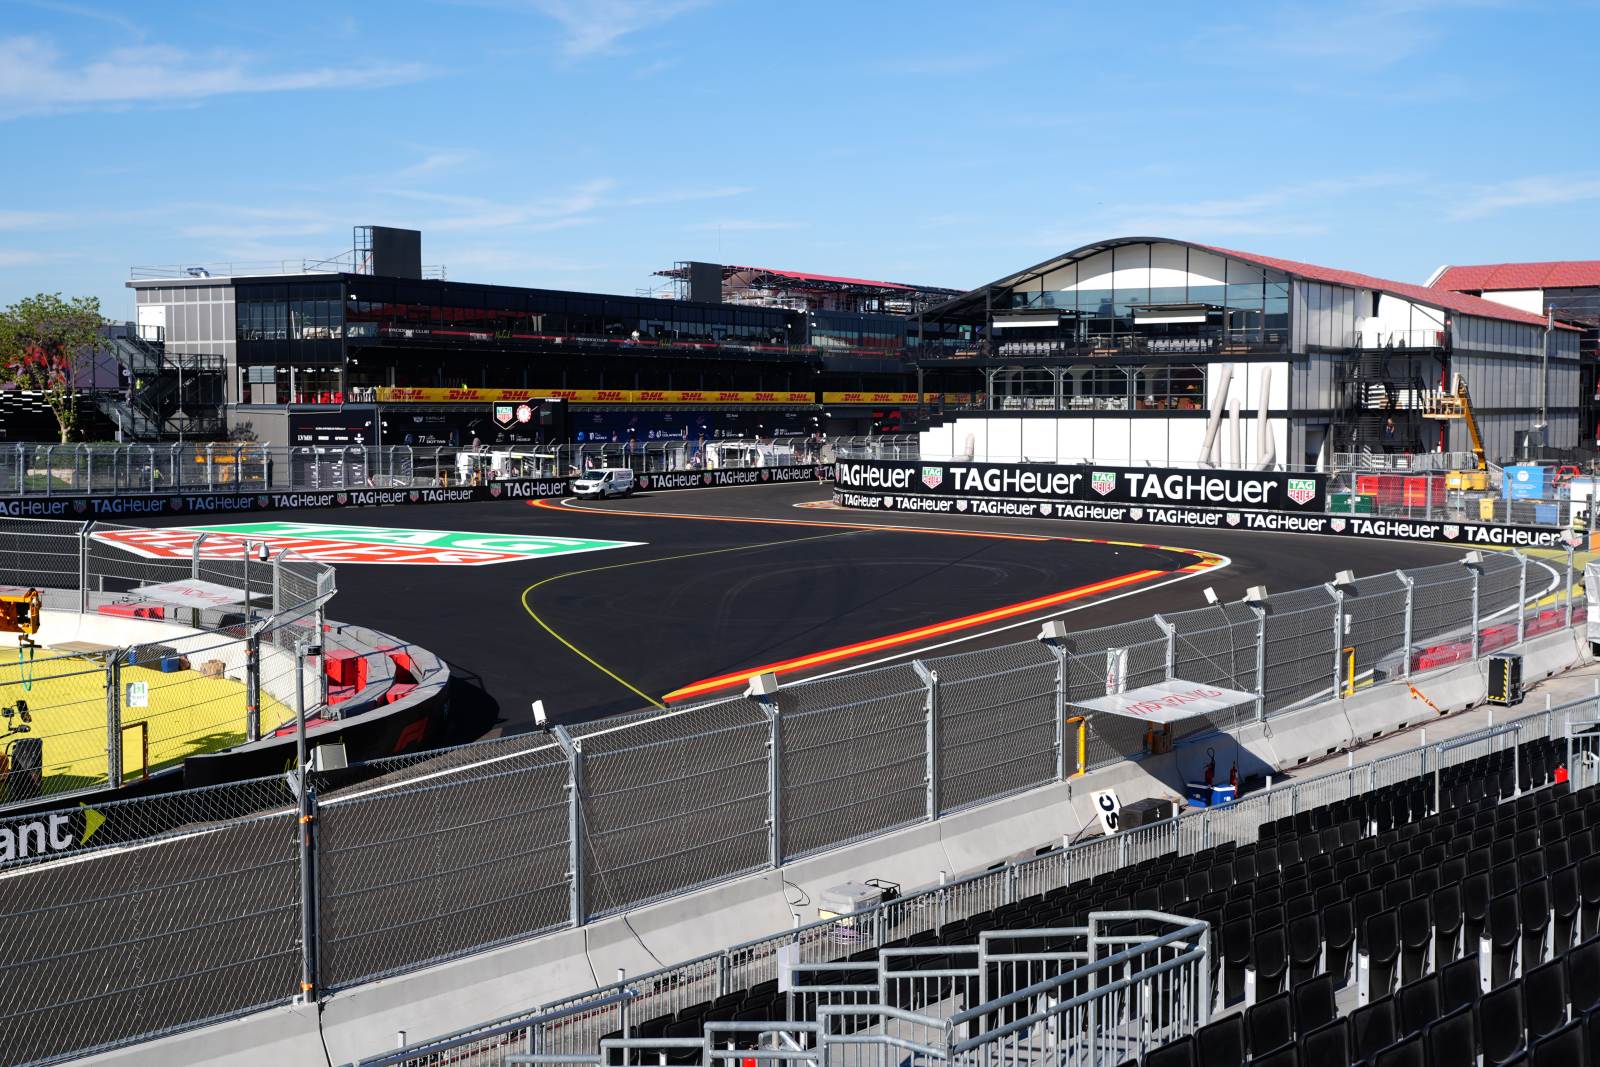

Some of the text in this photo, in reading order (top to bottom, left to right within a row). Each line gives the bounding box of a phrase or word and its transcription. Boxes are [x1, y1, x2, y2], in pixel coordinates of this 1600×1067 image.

[449, 390, 479, 400] DHL
[502, 391, 529, 400] DHL
[597, 392, 623, 400] DHL
[641, 392, 665, 400] DHL
[418, 435, 425, 443] 77
[651, 473, 702, 488] TAGHeuer
[714, 470, 759, 485] TAGHeuer
[771, 468, 813, 481] TAGHeuer
[950, 467, 1082, 495] TAGHeuer
[505, 480, 567, 498] TAGHeuer
[1124, 473, 1278, 504] TAGHeuer
[1290, 481, 1313, 489] TAG
[272, 494, 334, 508] TAGHeuer
[350, 491, 407, 506] TAGHeuer
[421, 488, 473, 501] TAGHeuer
[845, 494, 881, 508] TAGHeuer
[91, 499, 166, 513] TAGHeuer
[187, 497, 254, 511] TAGHeuer
[896, 497, 953, 511] TAGHeuer
[971, 500, 1036, 516] TAGHeuer
[1056, 504, 1126, 520] TAGHeuer
[1147, 509, 1222, 526] TAGHeuer
[1245, 513, 1327, 532] TAGHeuer
[1350, 519, 1439, 539] TAGHeuer
[1464, 526, 1559, 546] TAGHeuer
[1099, 795, 1118, 829] SC
[0, 814, 73, 861] ant
